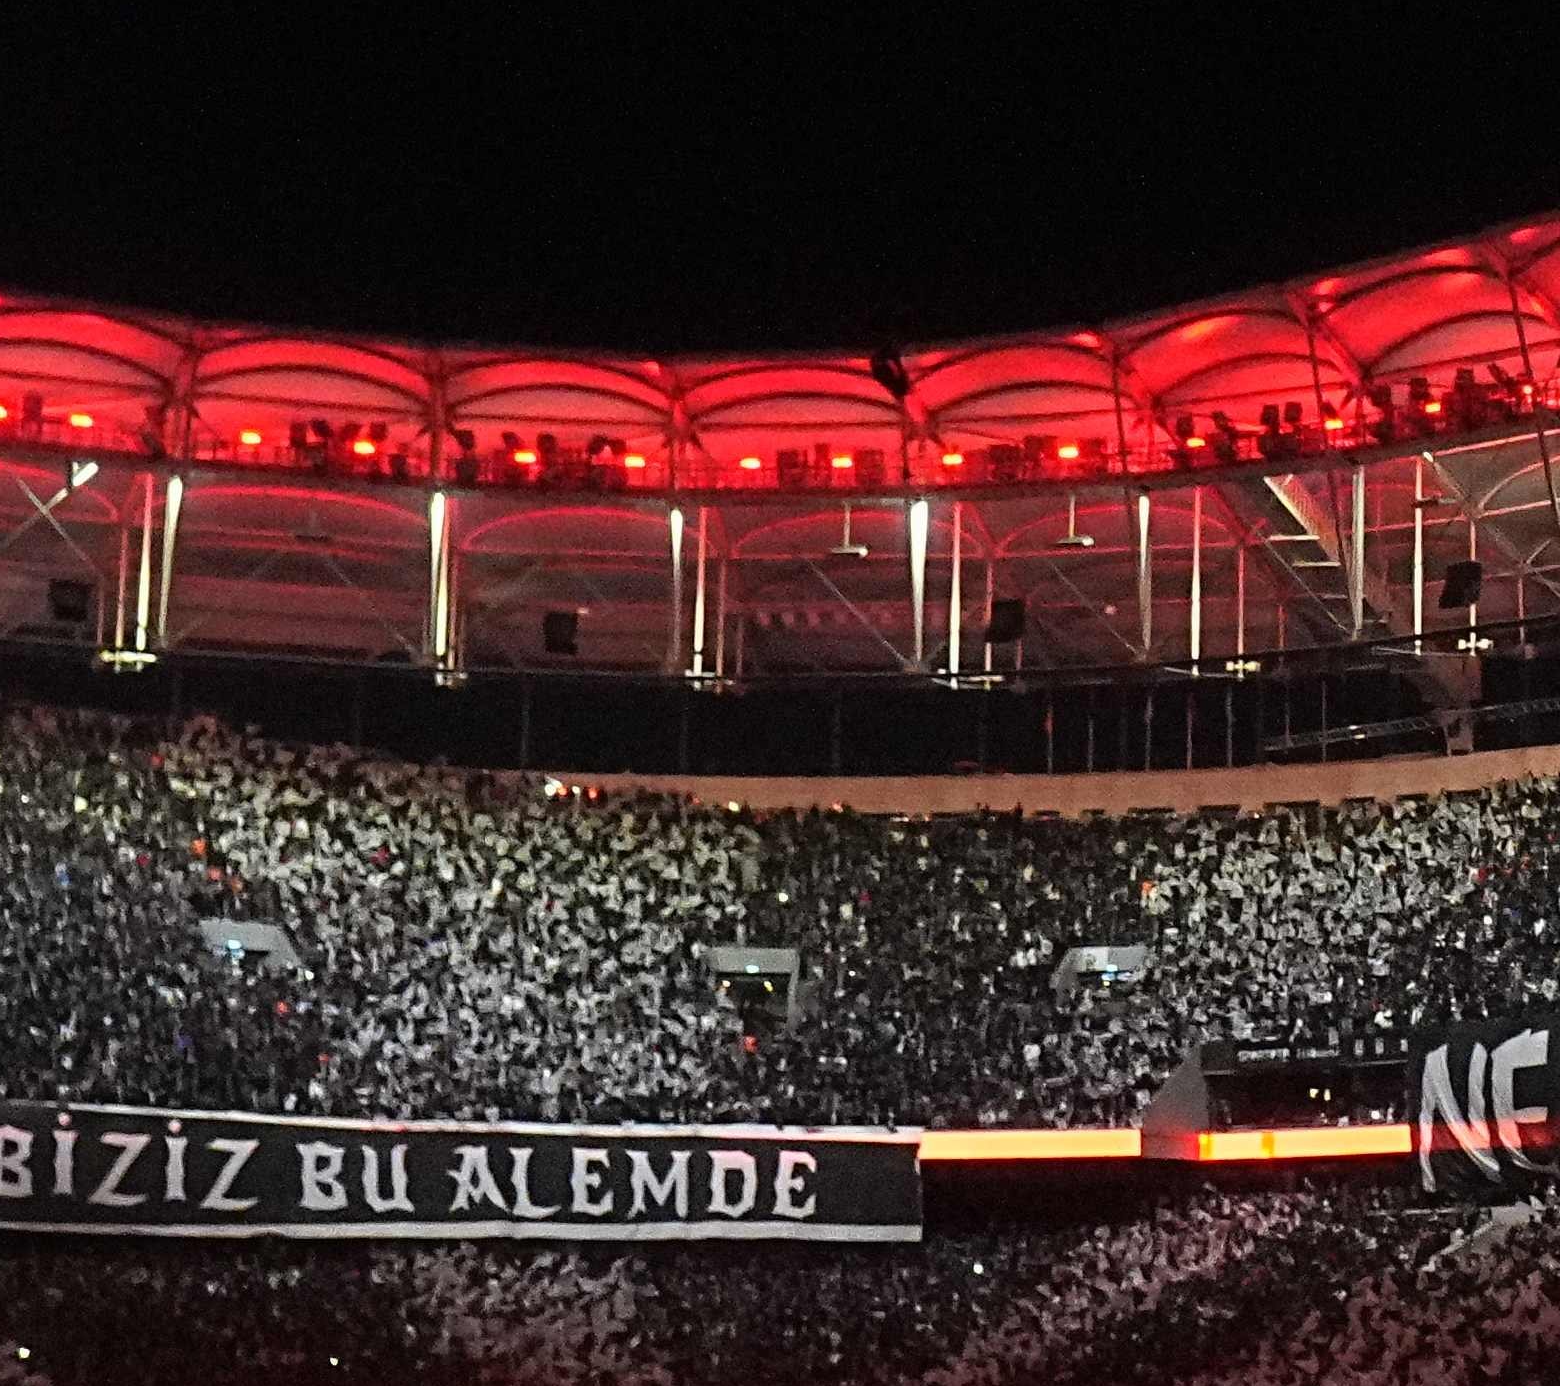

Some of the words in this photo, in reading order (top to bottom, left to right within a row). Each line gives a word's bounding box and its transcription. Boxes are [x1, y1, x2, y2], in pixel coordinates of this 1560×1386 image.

[1419, 1027, 1560, 1194] NE
[295, 1139, 415, 1214] BU
[447, 1143, 819, 1219] ALEMDE
